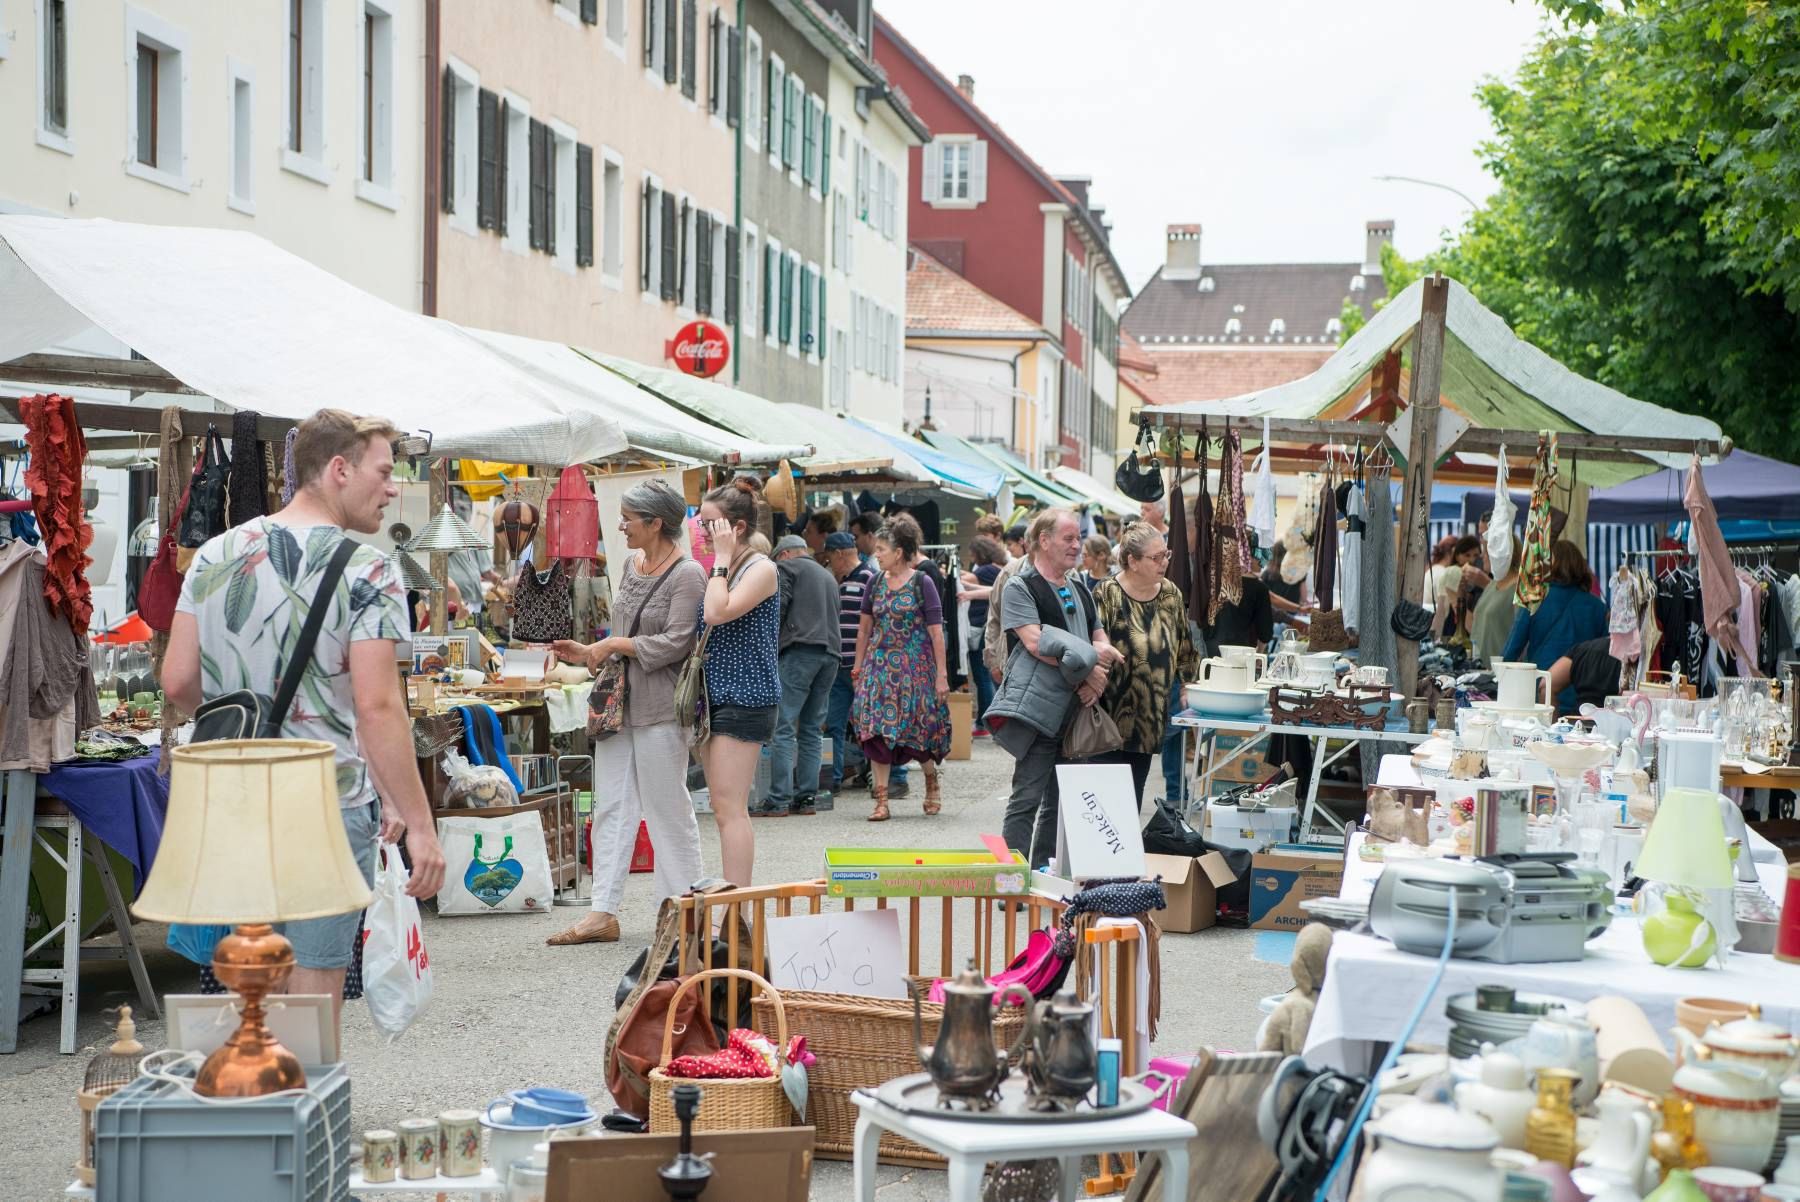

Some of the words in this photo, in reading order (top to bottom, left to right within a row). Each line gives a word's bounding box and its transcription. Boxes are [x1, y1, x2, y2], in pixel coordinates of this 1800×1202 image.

[1081, 791, 1097, 811] up
[1095, 812, 1125, 855] Make
[832, 872, 871, 880] Clementoni
[1274, 916, 1309, 927] ARCHI
